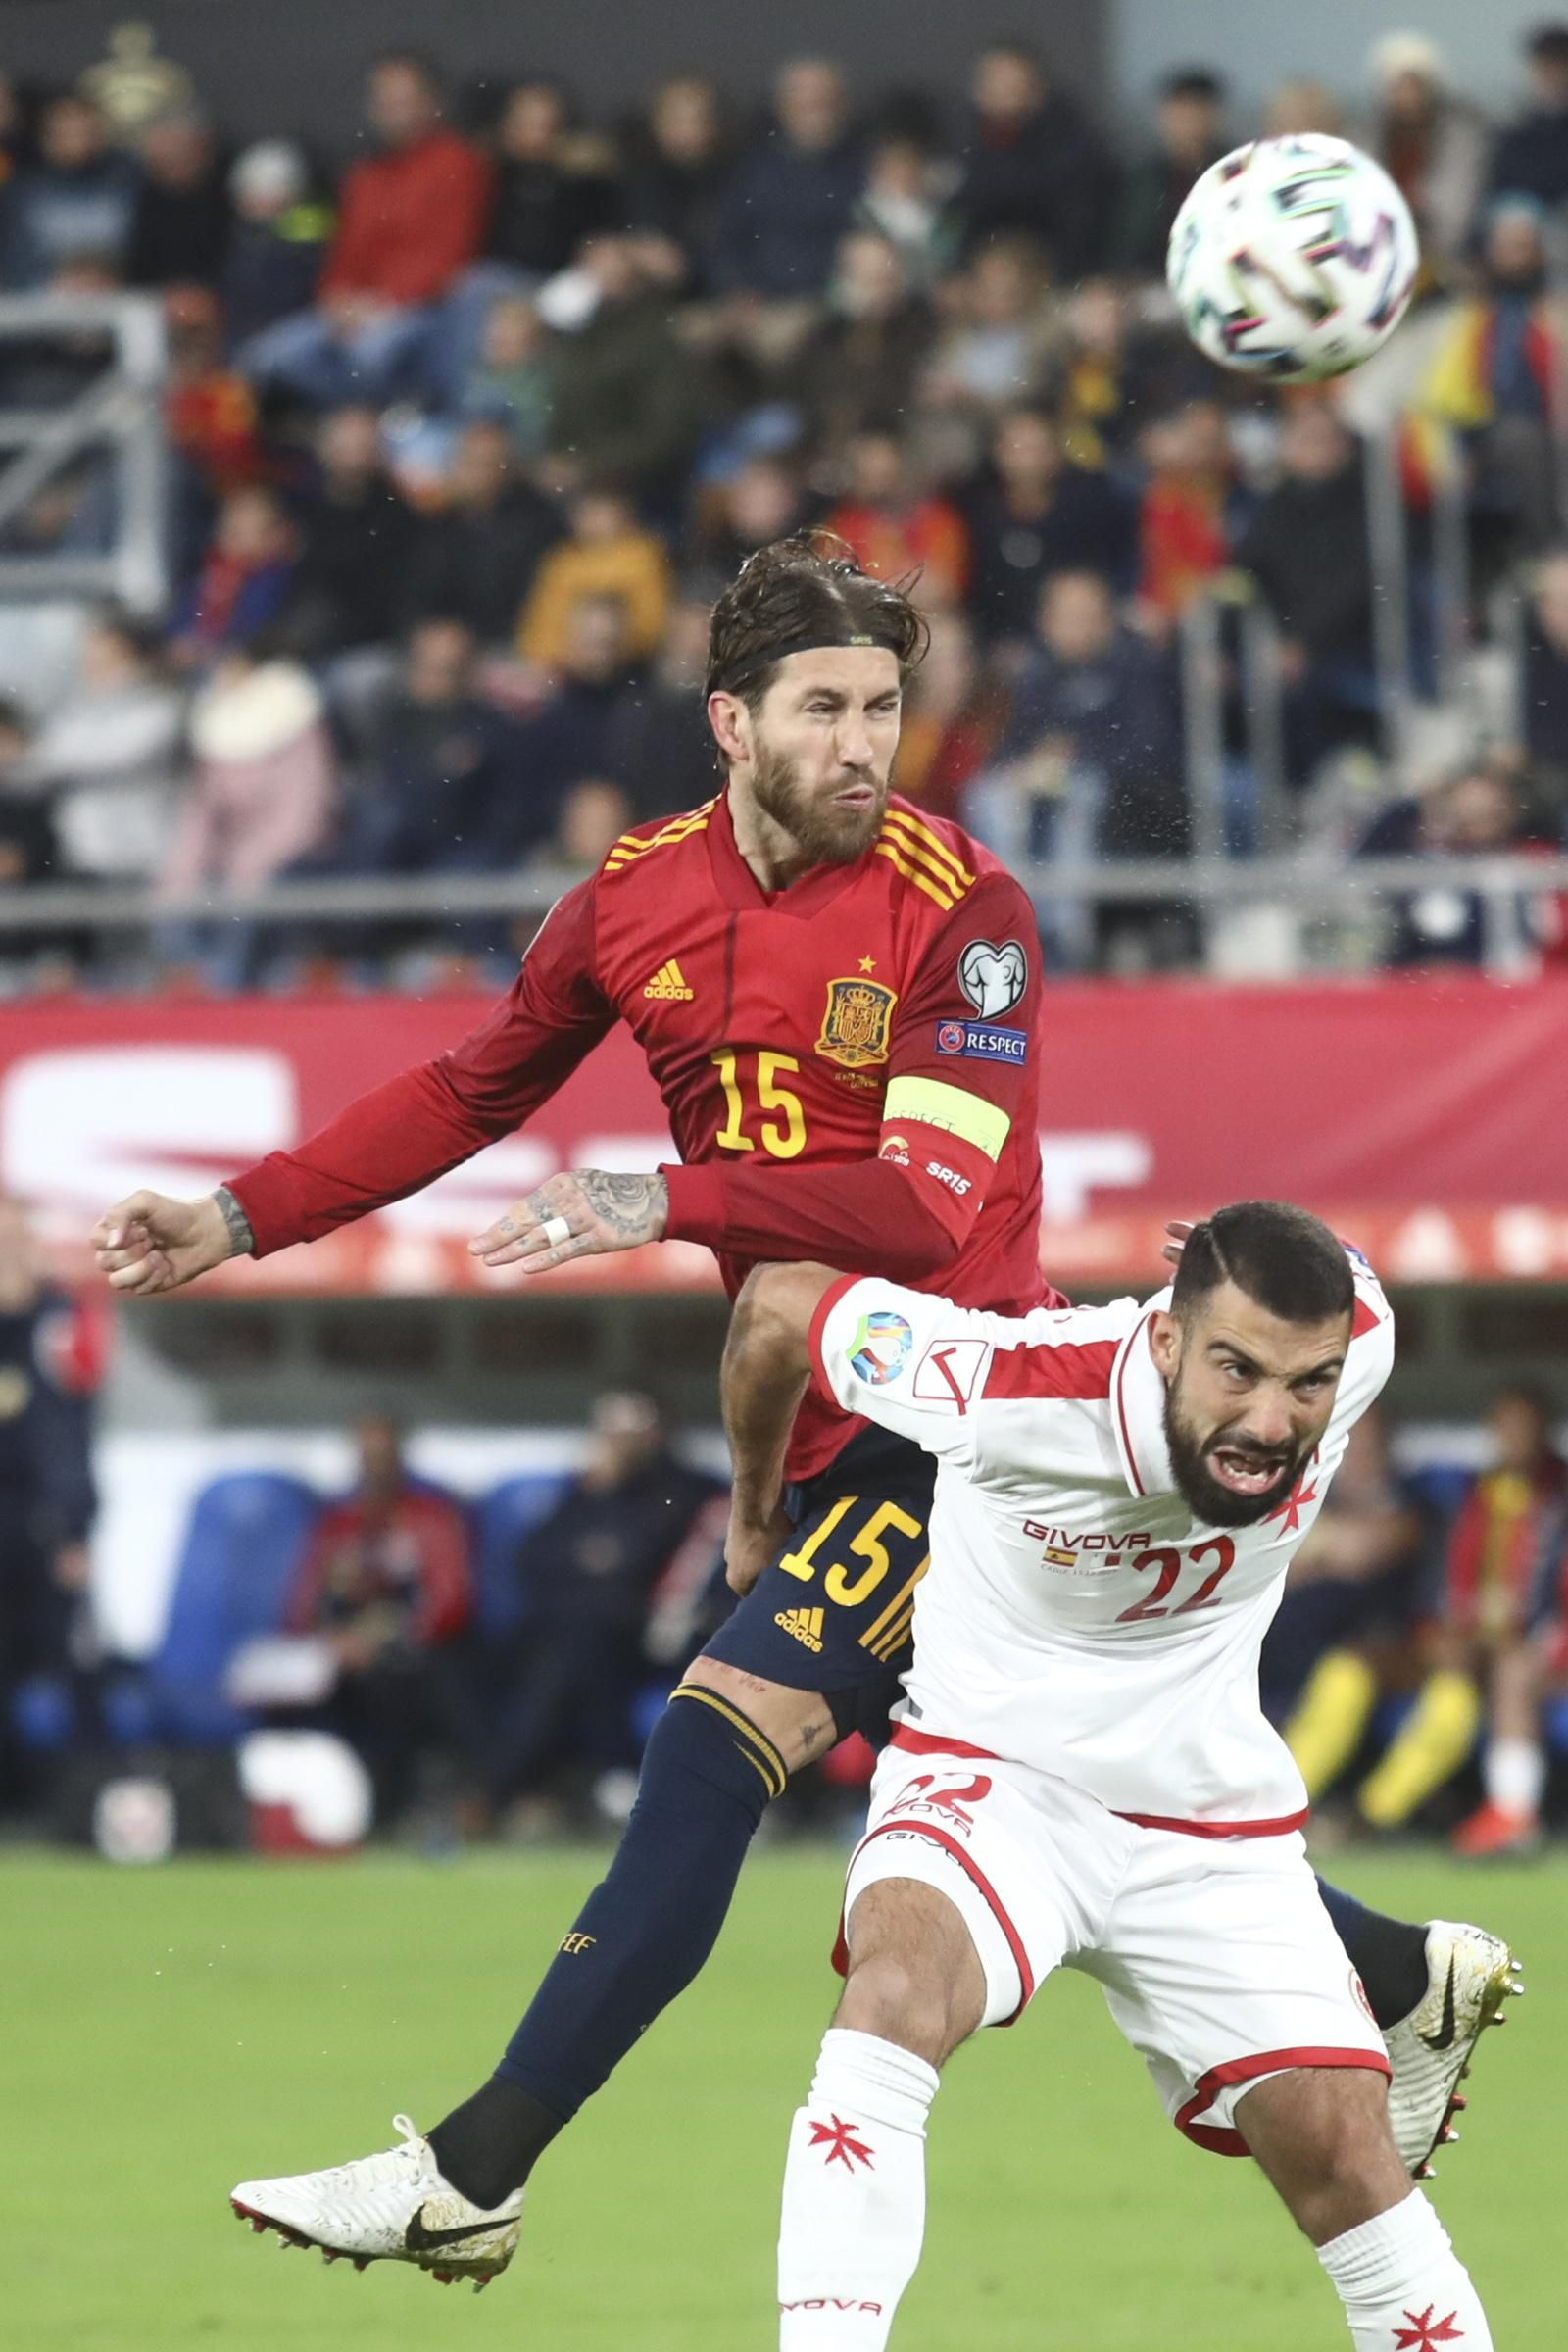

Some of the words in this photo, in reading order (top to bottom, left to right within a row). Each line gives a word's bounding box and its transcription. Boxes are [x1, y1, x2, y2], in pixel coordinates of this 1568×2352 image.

[643, 984, 694, 1001] adidas
[966, 1033, 1027, 1056] RESPECT
[710, 1048, 807, 1159] 15
[926, 1161, 972, 1195] SR15
[779, 1495, 923, 1607] 15
[1022, 1520, 1152, 1550] GIVOVA
[1114, 1534, 1235, 1623] 22
[773, 1611, 823, 1653] adidas
[558, 1933, 597, 1955] FEF
[778, 2298, 882, 2316] VOVA
